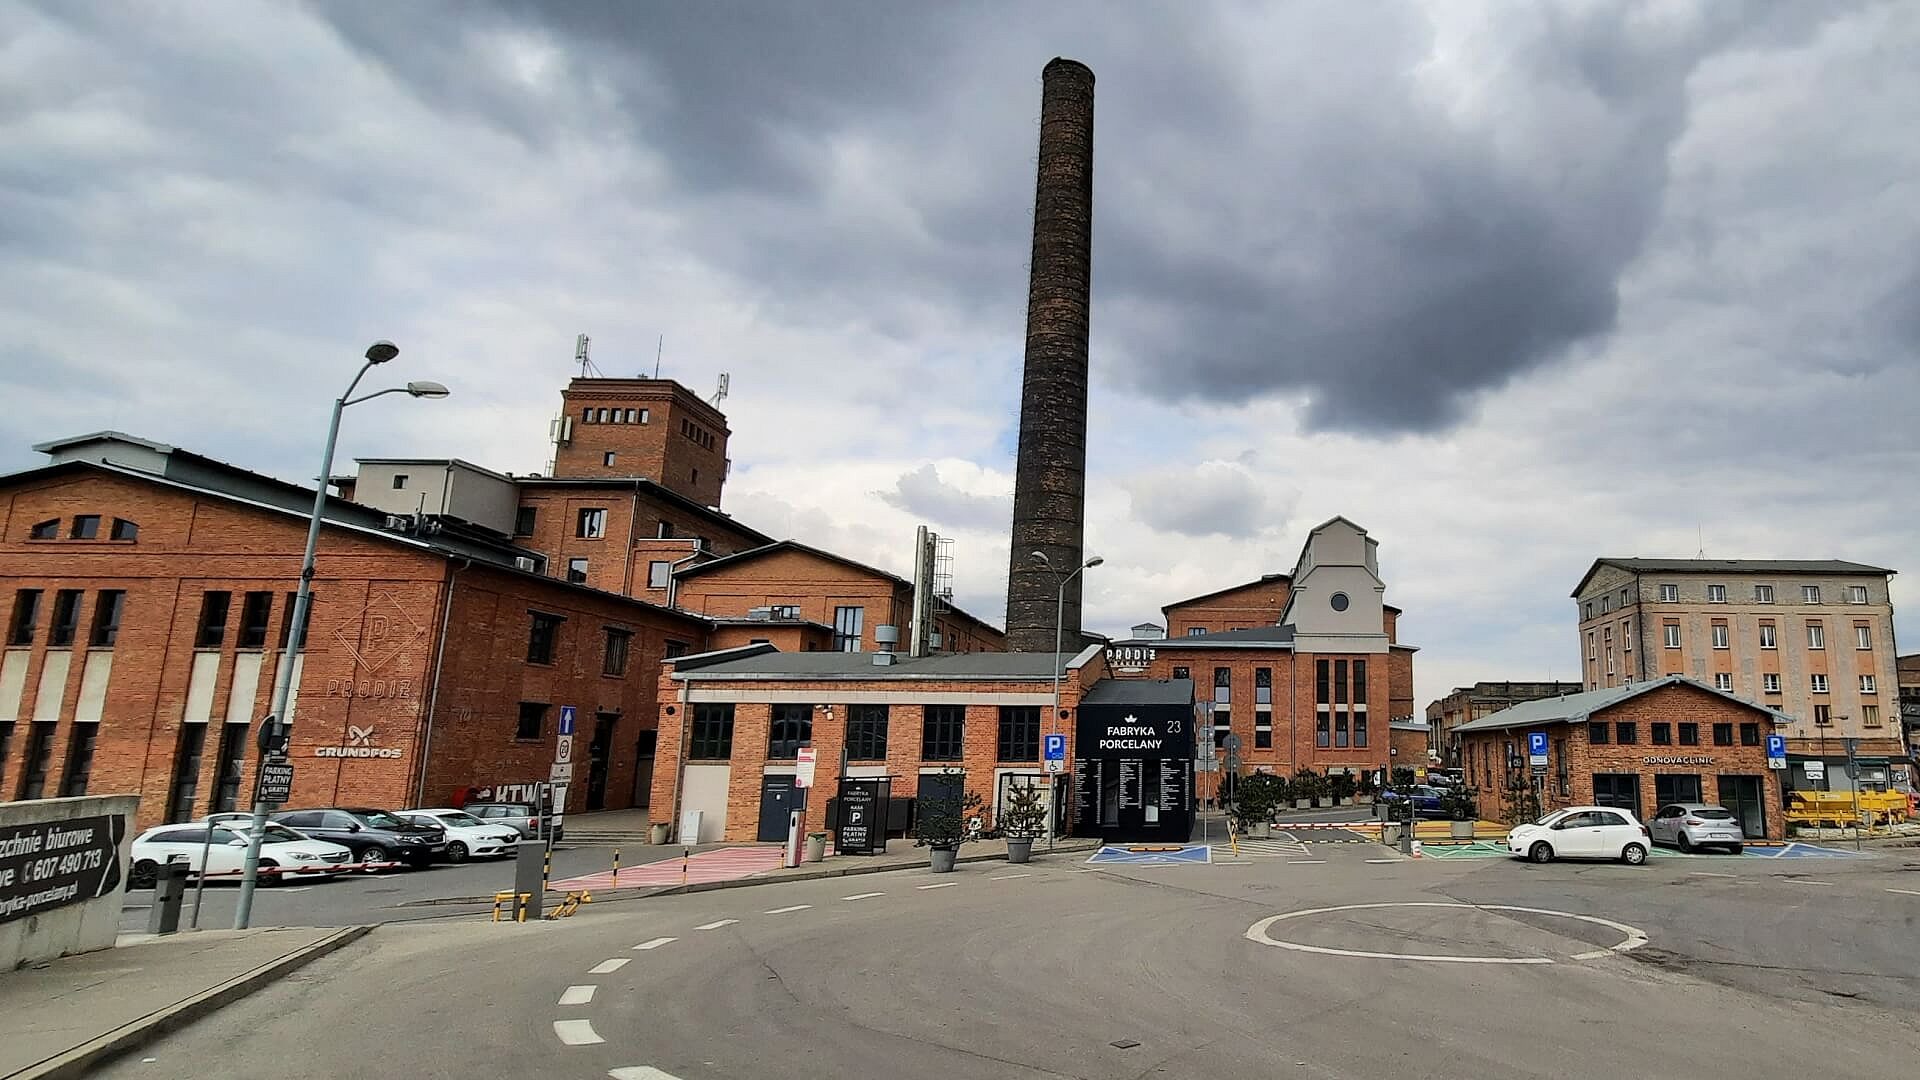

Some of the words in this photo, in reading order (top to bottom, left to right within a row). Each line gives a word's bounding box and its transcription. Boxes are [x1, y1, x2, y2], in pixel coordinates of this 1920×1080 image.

[1107, 726, 1156, 736] FABRYKA
[1167, 720, 1182, 734] 23
[1049, 736, 1061, 753] P
[1099, 739, 1163, 749] PORCELANY
[1532, 735, 1543, 750] P
[1770, 737, 1781, 751] P
[314, 747, 403, 759] GRUNDFOS
[264, 766, 293, 775] PARKING
[852, 812, 861, 823] P
[45, 827, 94, 850] biurowe
[33, 856, 60, 881] 607
[59, 852, 82, 875] 490
[81, 849, 103, 871] 713
